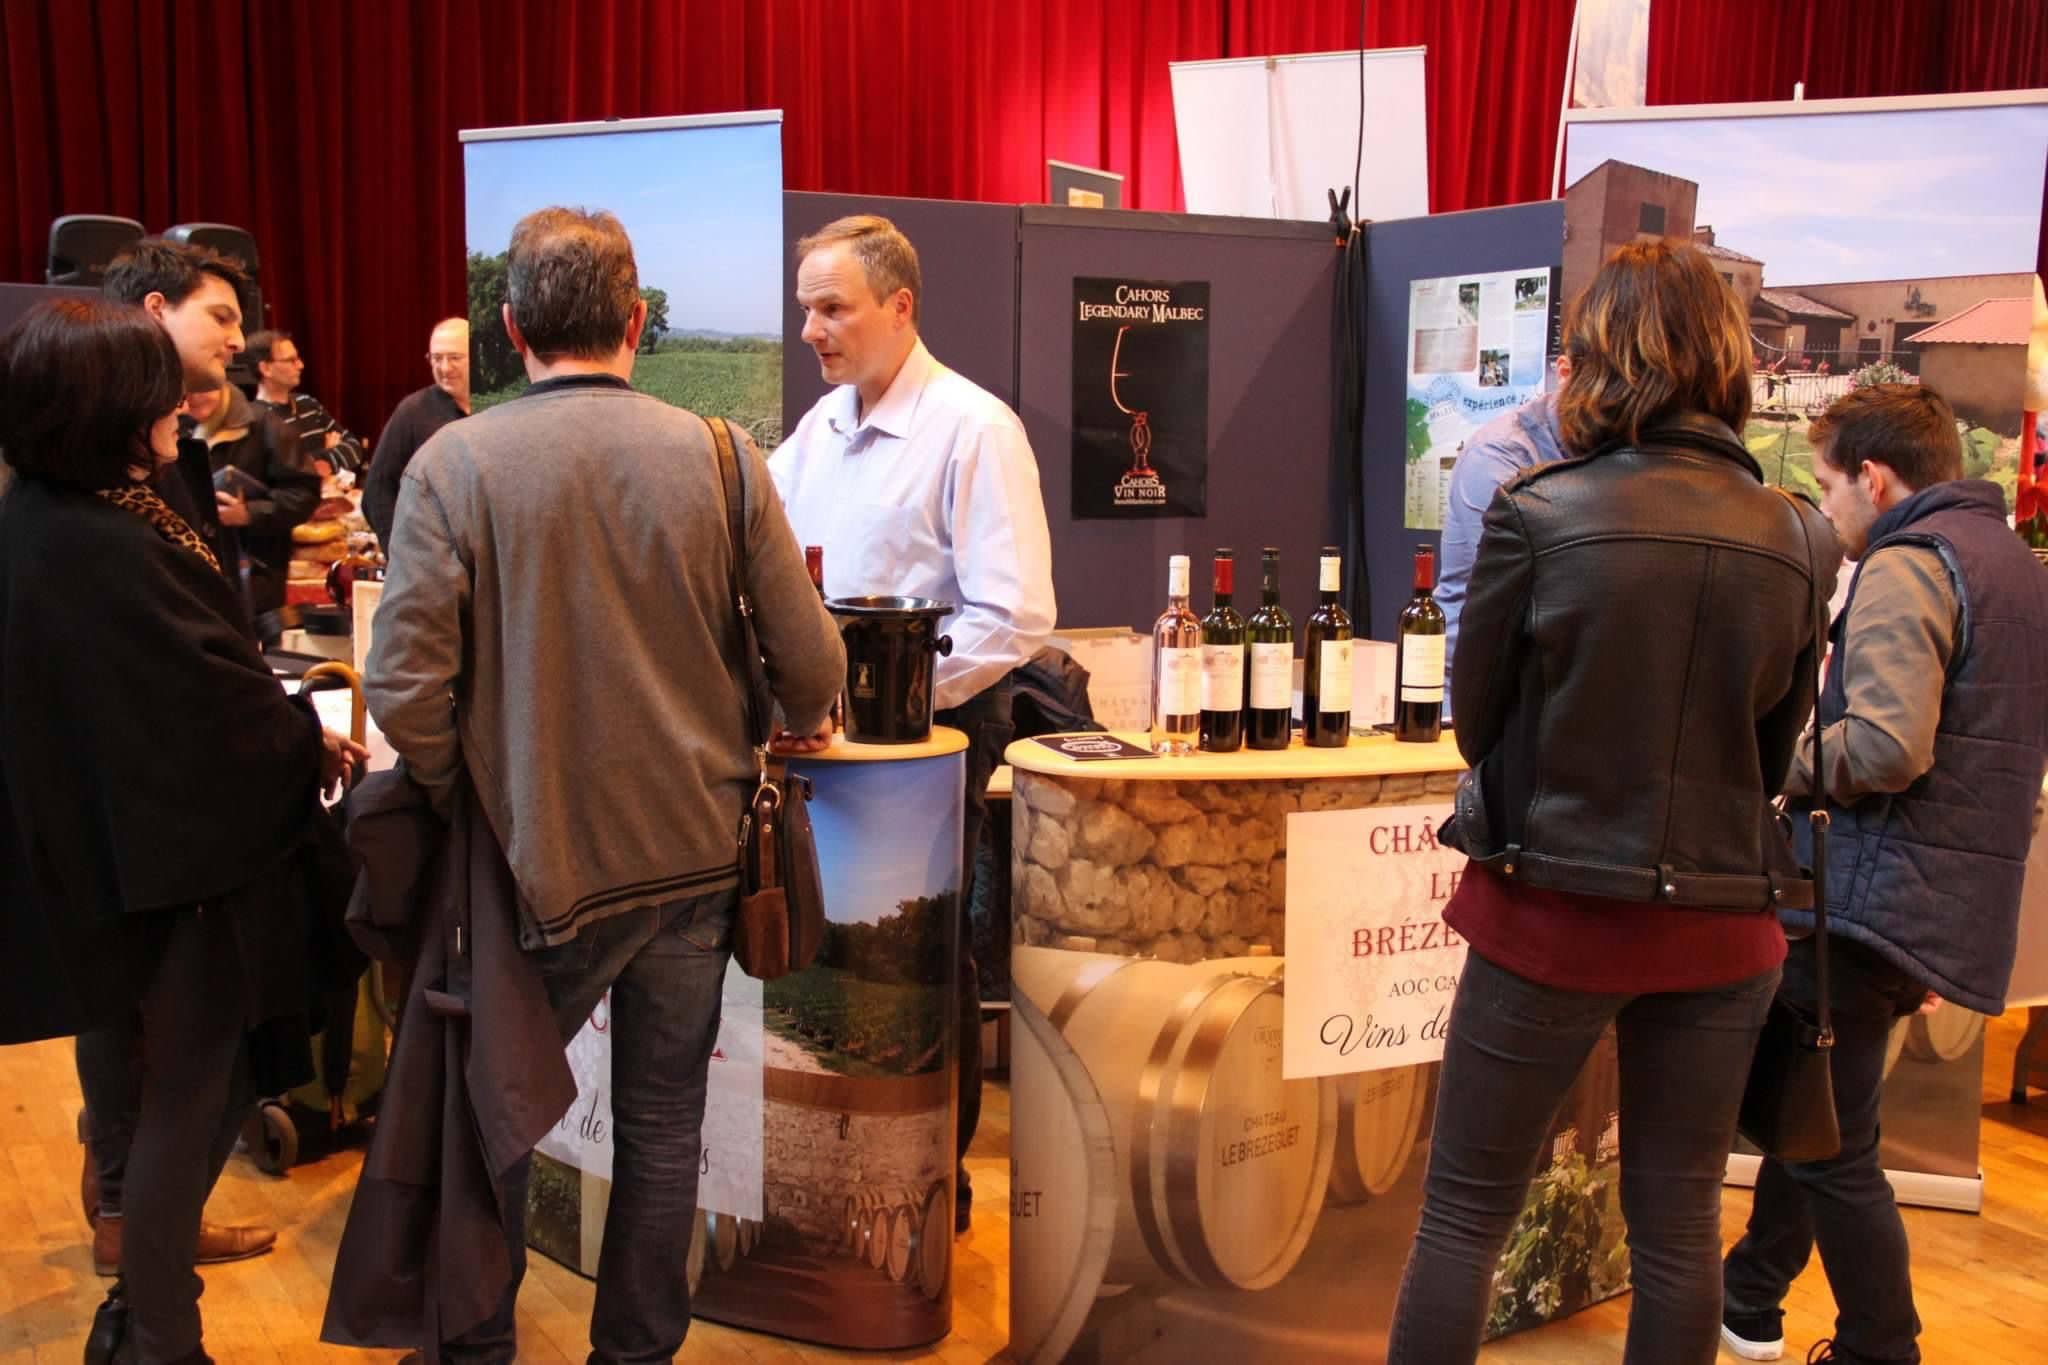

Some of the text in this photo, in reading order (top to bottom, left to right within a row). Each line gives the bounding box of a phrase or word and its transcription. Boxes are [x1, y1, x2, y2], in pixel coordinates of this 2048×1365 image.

[1116, 285, 1170, 304] CAHORS
[1080, 301, 1204, 323] LEGENDARY MALBEC
[1114, 485, 1166, 498] VIN NOIR
[1369, 816, 1439, 855] CHÂ
[1353, 917, 1460, 958] BRÉZE
[1388, 975, 1458, 998] AOC CA
[1319, 1013, 1408, 1056] Vins
[1421, 1005, 1449, 1041] de
[580, 1087, 608, 1143] de
